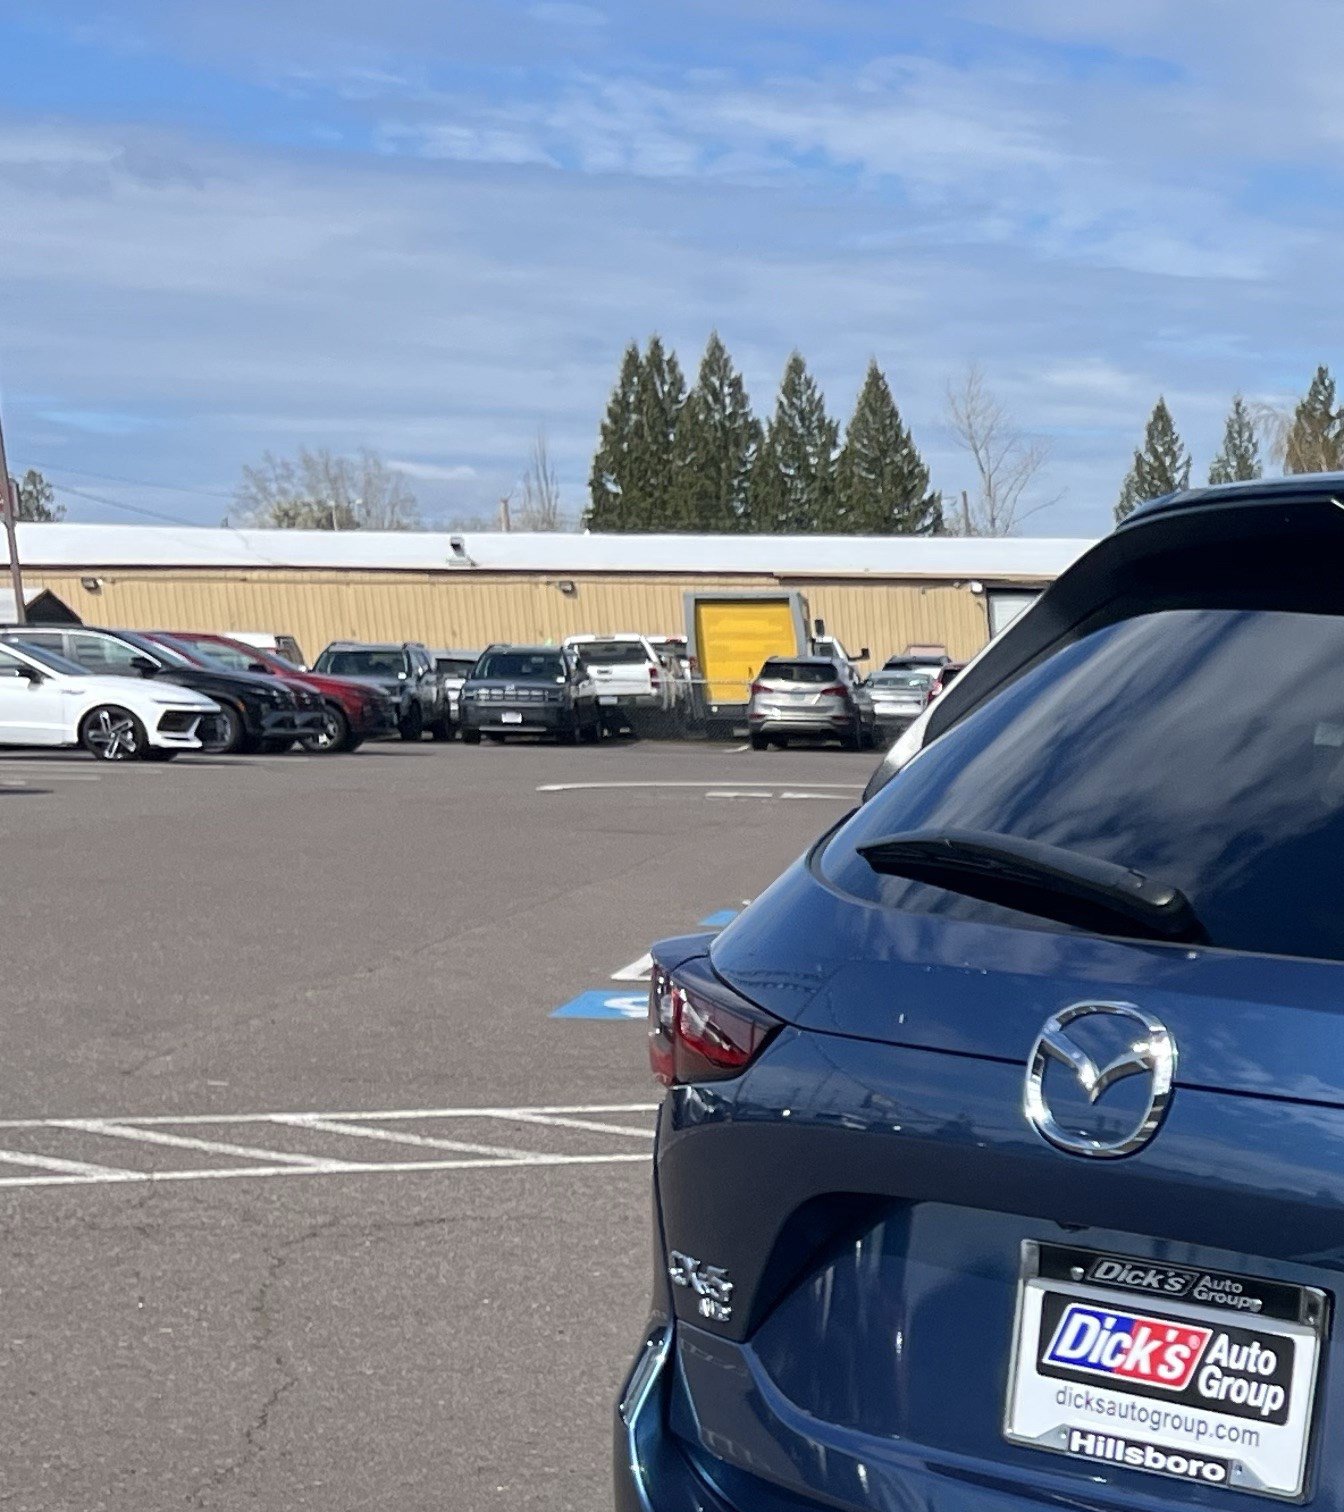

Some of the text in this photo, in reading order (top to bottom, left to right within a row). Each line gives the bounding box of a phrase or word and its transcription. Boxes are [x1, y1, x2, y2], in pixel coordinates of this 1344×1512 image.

[1094, 1260, 1187, 1292] Dick's
[1193, 1287, 1253, 1310] Group
[1198, 1275, 1244, 1294] Auto
[1054, 1312, 1192, 1381] Dick's
[1204, 1332, 1278, 1376] Auto
[1197, 1364, 1286, 1415] Group
[1055, 1386, 1261, 1448] dicksautogroup.com
[1069, 1430, 1227, 1482] Hillsboro
